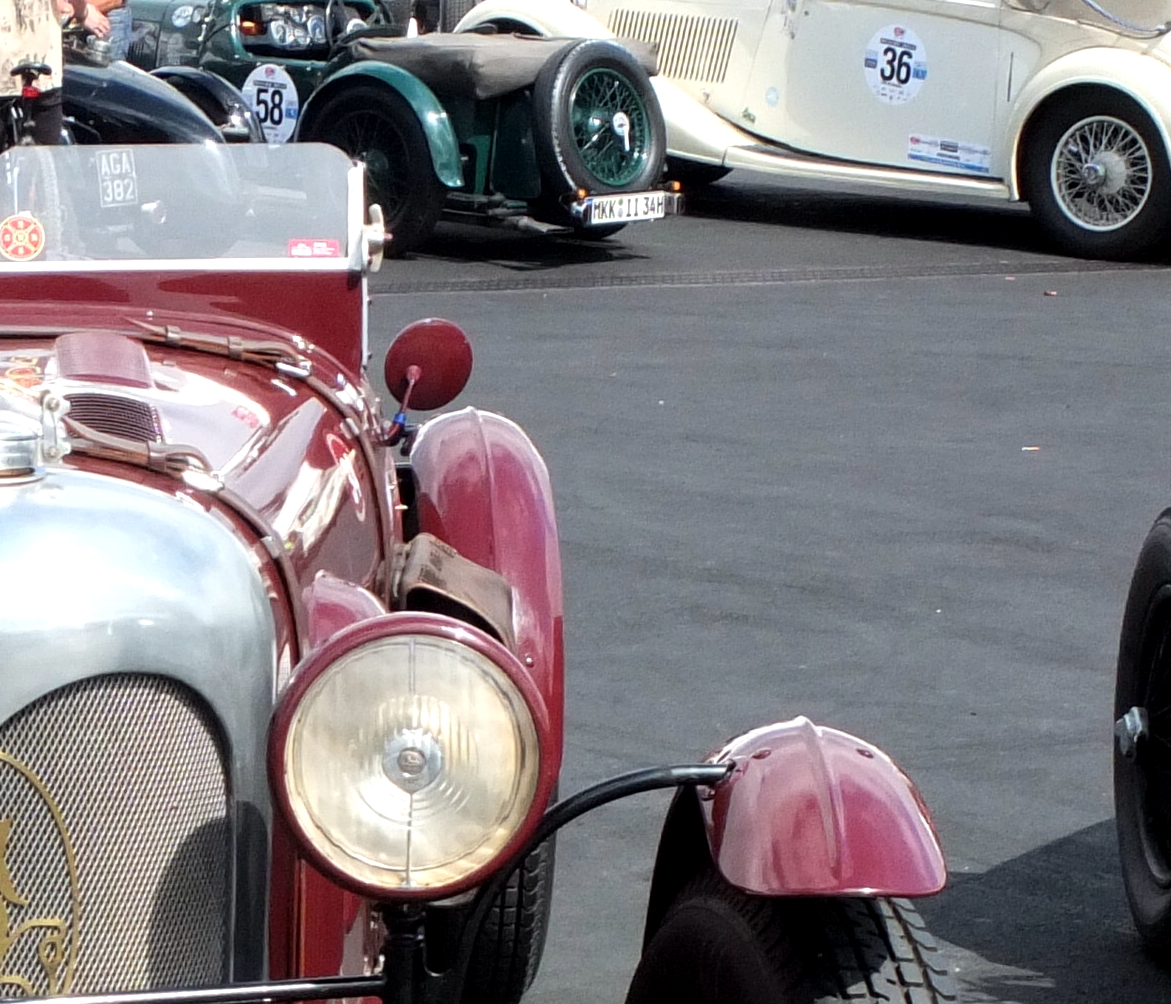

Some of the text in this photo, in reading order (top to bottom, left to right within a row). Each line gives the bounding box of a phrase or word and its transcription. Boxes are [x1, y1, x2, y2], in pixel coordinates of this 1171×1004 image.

[880, 46, 913, 85] 36
[255, 87, 284, 126] 58
[101, 152, 131, 176] AGA
[103, 178, 135, 203] 382
